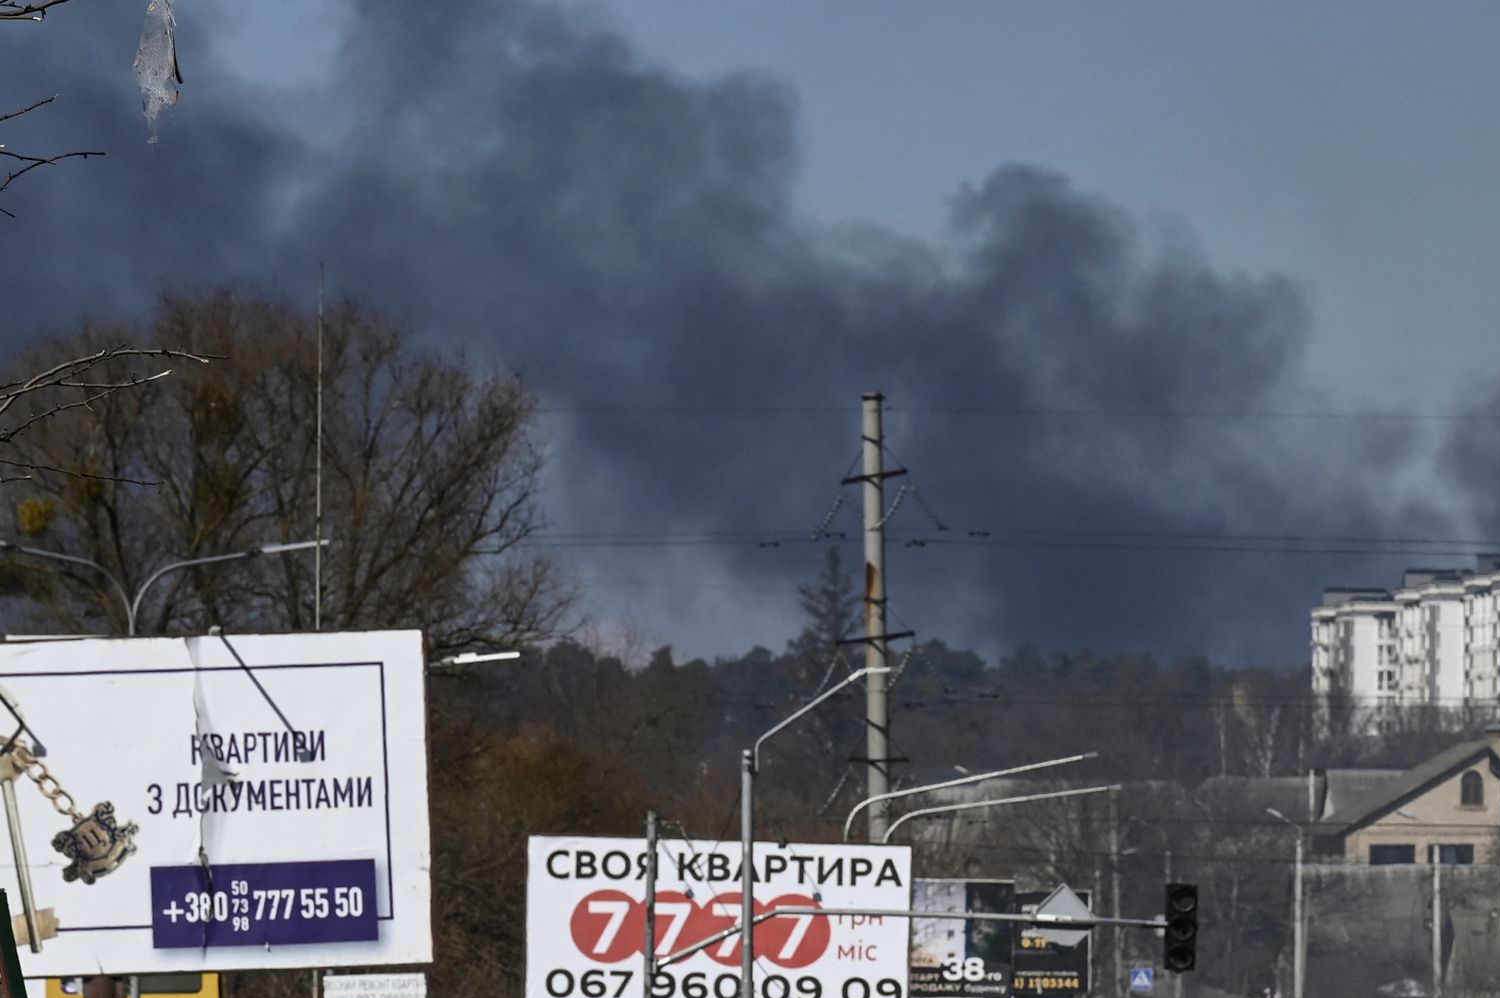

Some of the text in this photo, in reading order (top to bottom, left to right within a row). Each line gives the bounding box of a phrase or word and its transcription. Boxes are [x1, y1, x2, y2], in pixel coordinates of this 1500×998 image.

[190, 730, 326, 765] КВАРТИРИ
[172, 776, 373, 819] ДОКУМЕНТАМИ
[545, 849, 902, 888] СВОЯ КВАРТИРА
[231, 880, 249, 897] 50
[162, 886, 363, 924] +380 777 55 50
[231, 898, 249, 914] 73
[233, 916, 250, 932] 98
[837, 940, 878, 961] міс
[545, 969, 634, 998] 067
